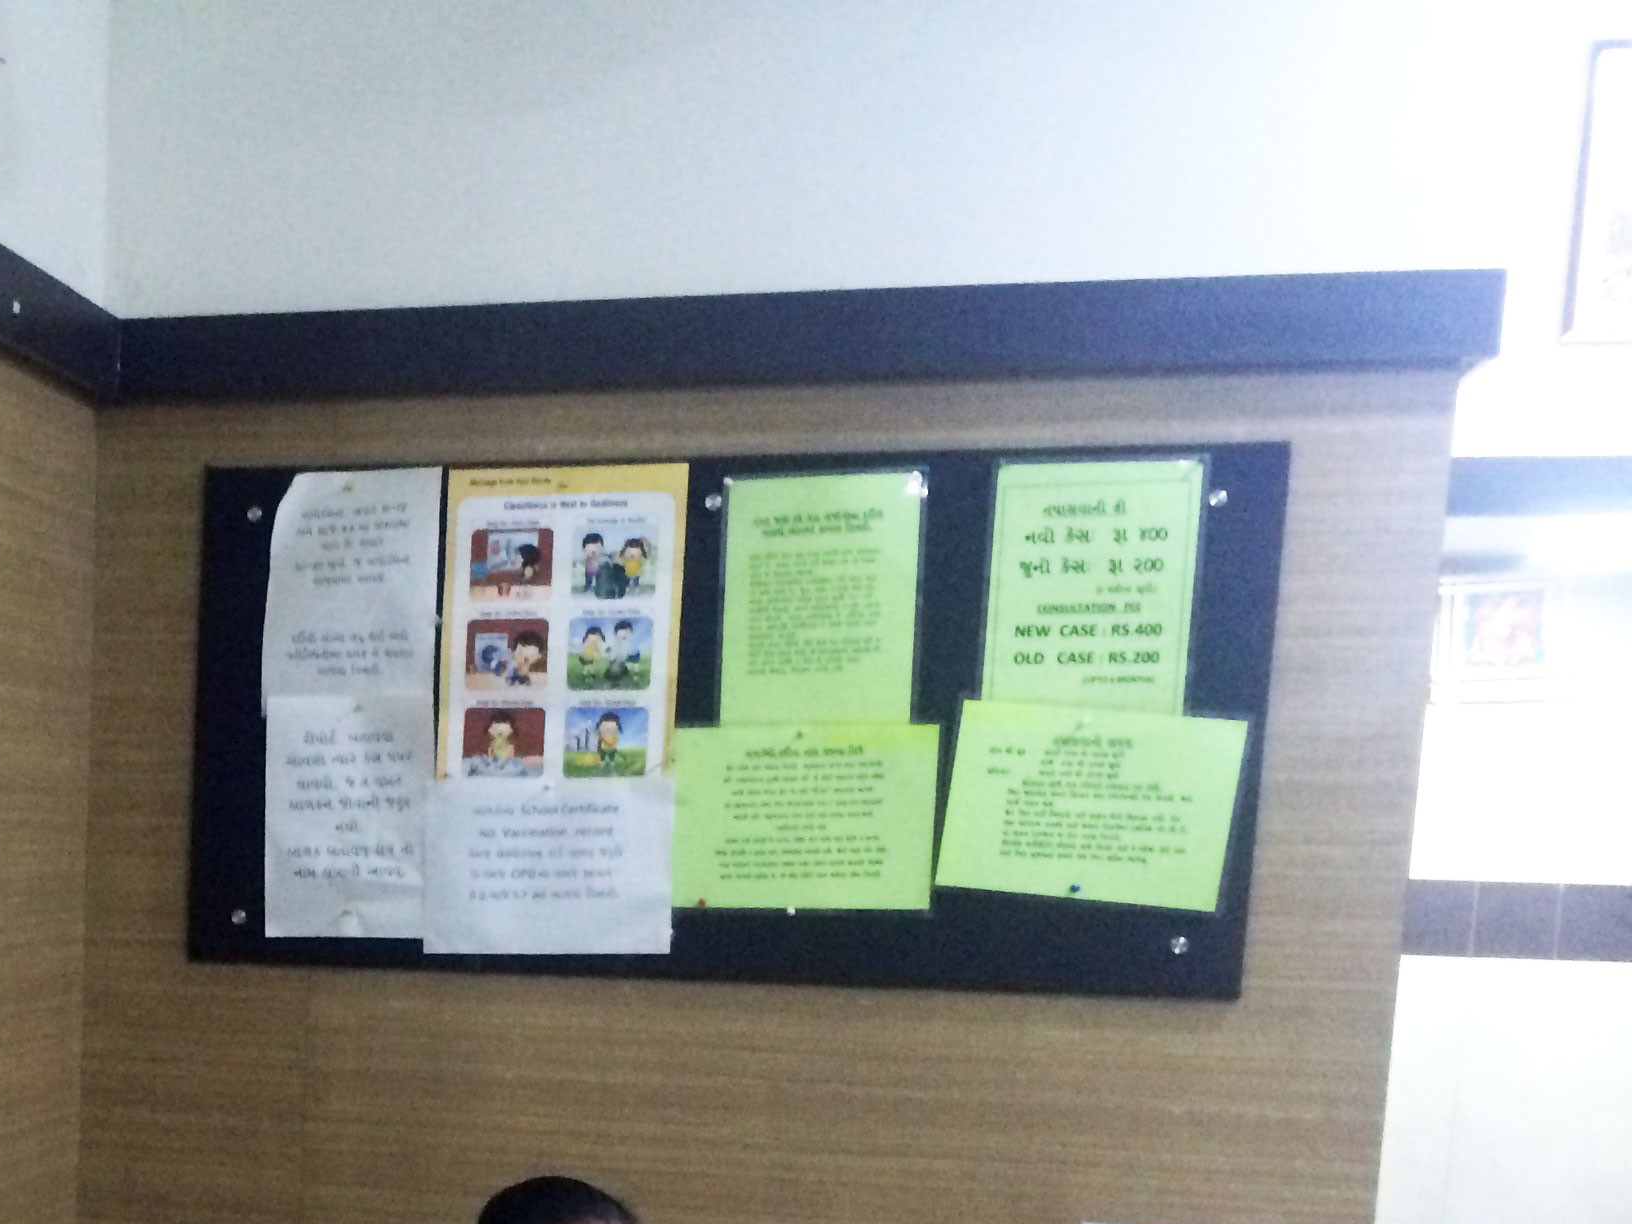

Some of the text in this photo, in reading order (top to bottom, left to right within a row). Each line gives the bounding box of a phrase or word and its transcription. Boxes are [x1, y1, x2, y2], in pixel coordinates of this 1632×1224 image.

[1014, 624, 1051, 637] NEW
[1059, 624, 1097, 637] CASE
[1013, 651, 1045, 665] OLD
[1057, 651, 1094, 665] CASE
[520, 803, 558, 815] School
[560, 803, 619, 815] Certificate
